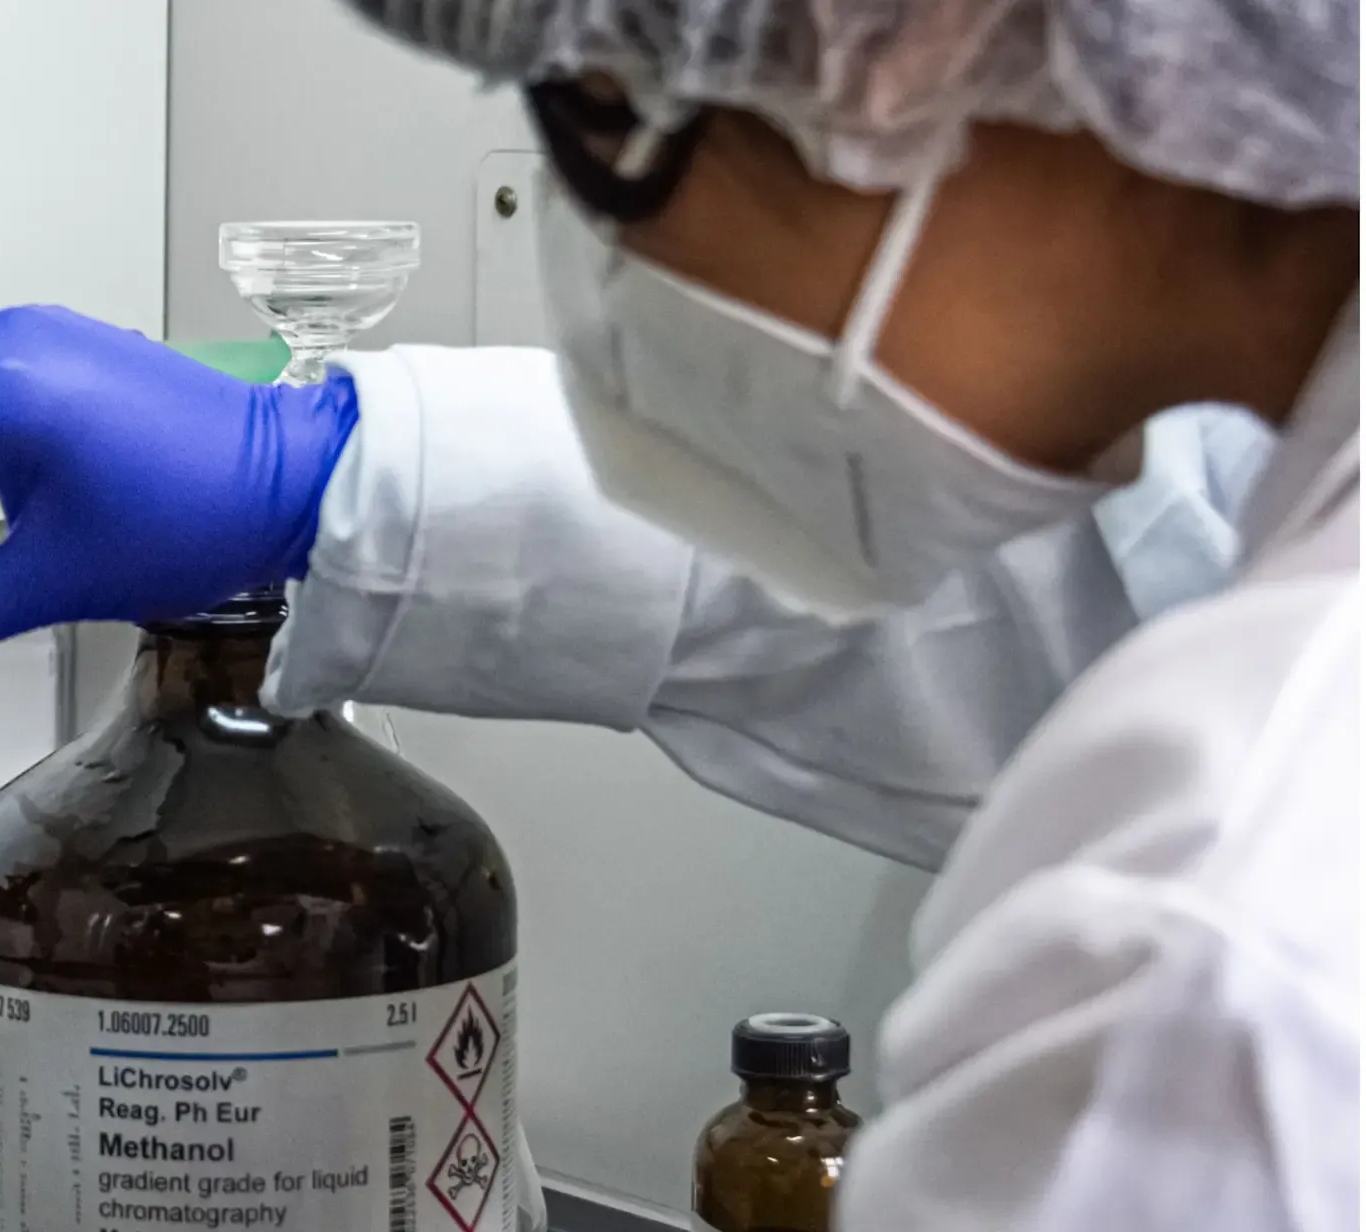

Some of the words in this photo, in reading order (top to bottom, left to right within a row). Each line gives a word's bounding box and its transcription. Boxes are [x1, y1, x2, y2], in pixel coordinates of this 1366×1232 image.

[7, 997, 30, 1022] 539
[98, 1009, 210, 1037] 1.06007.2500
[387, 1004, 409, 1026] 2.5
[99, 1097, 166, 1126] Reag.
[175, 1101, 208, 1123] Ph
[216, 1101, 262, 1123] Eur
[99, 1131, 235, 1162] Methanol
[98, 1170, 191, 1193] gradient
[197, 1173, 266, 1199] grade
[273, 1171, 305, 1193] for
[311, 1165, 369, 1194] liquid
[98, 1199, 287, 1229] chromatography
